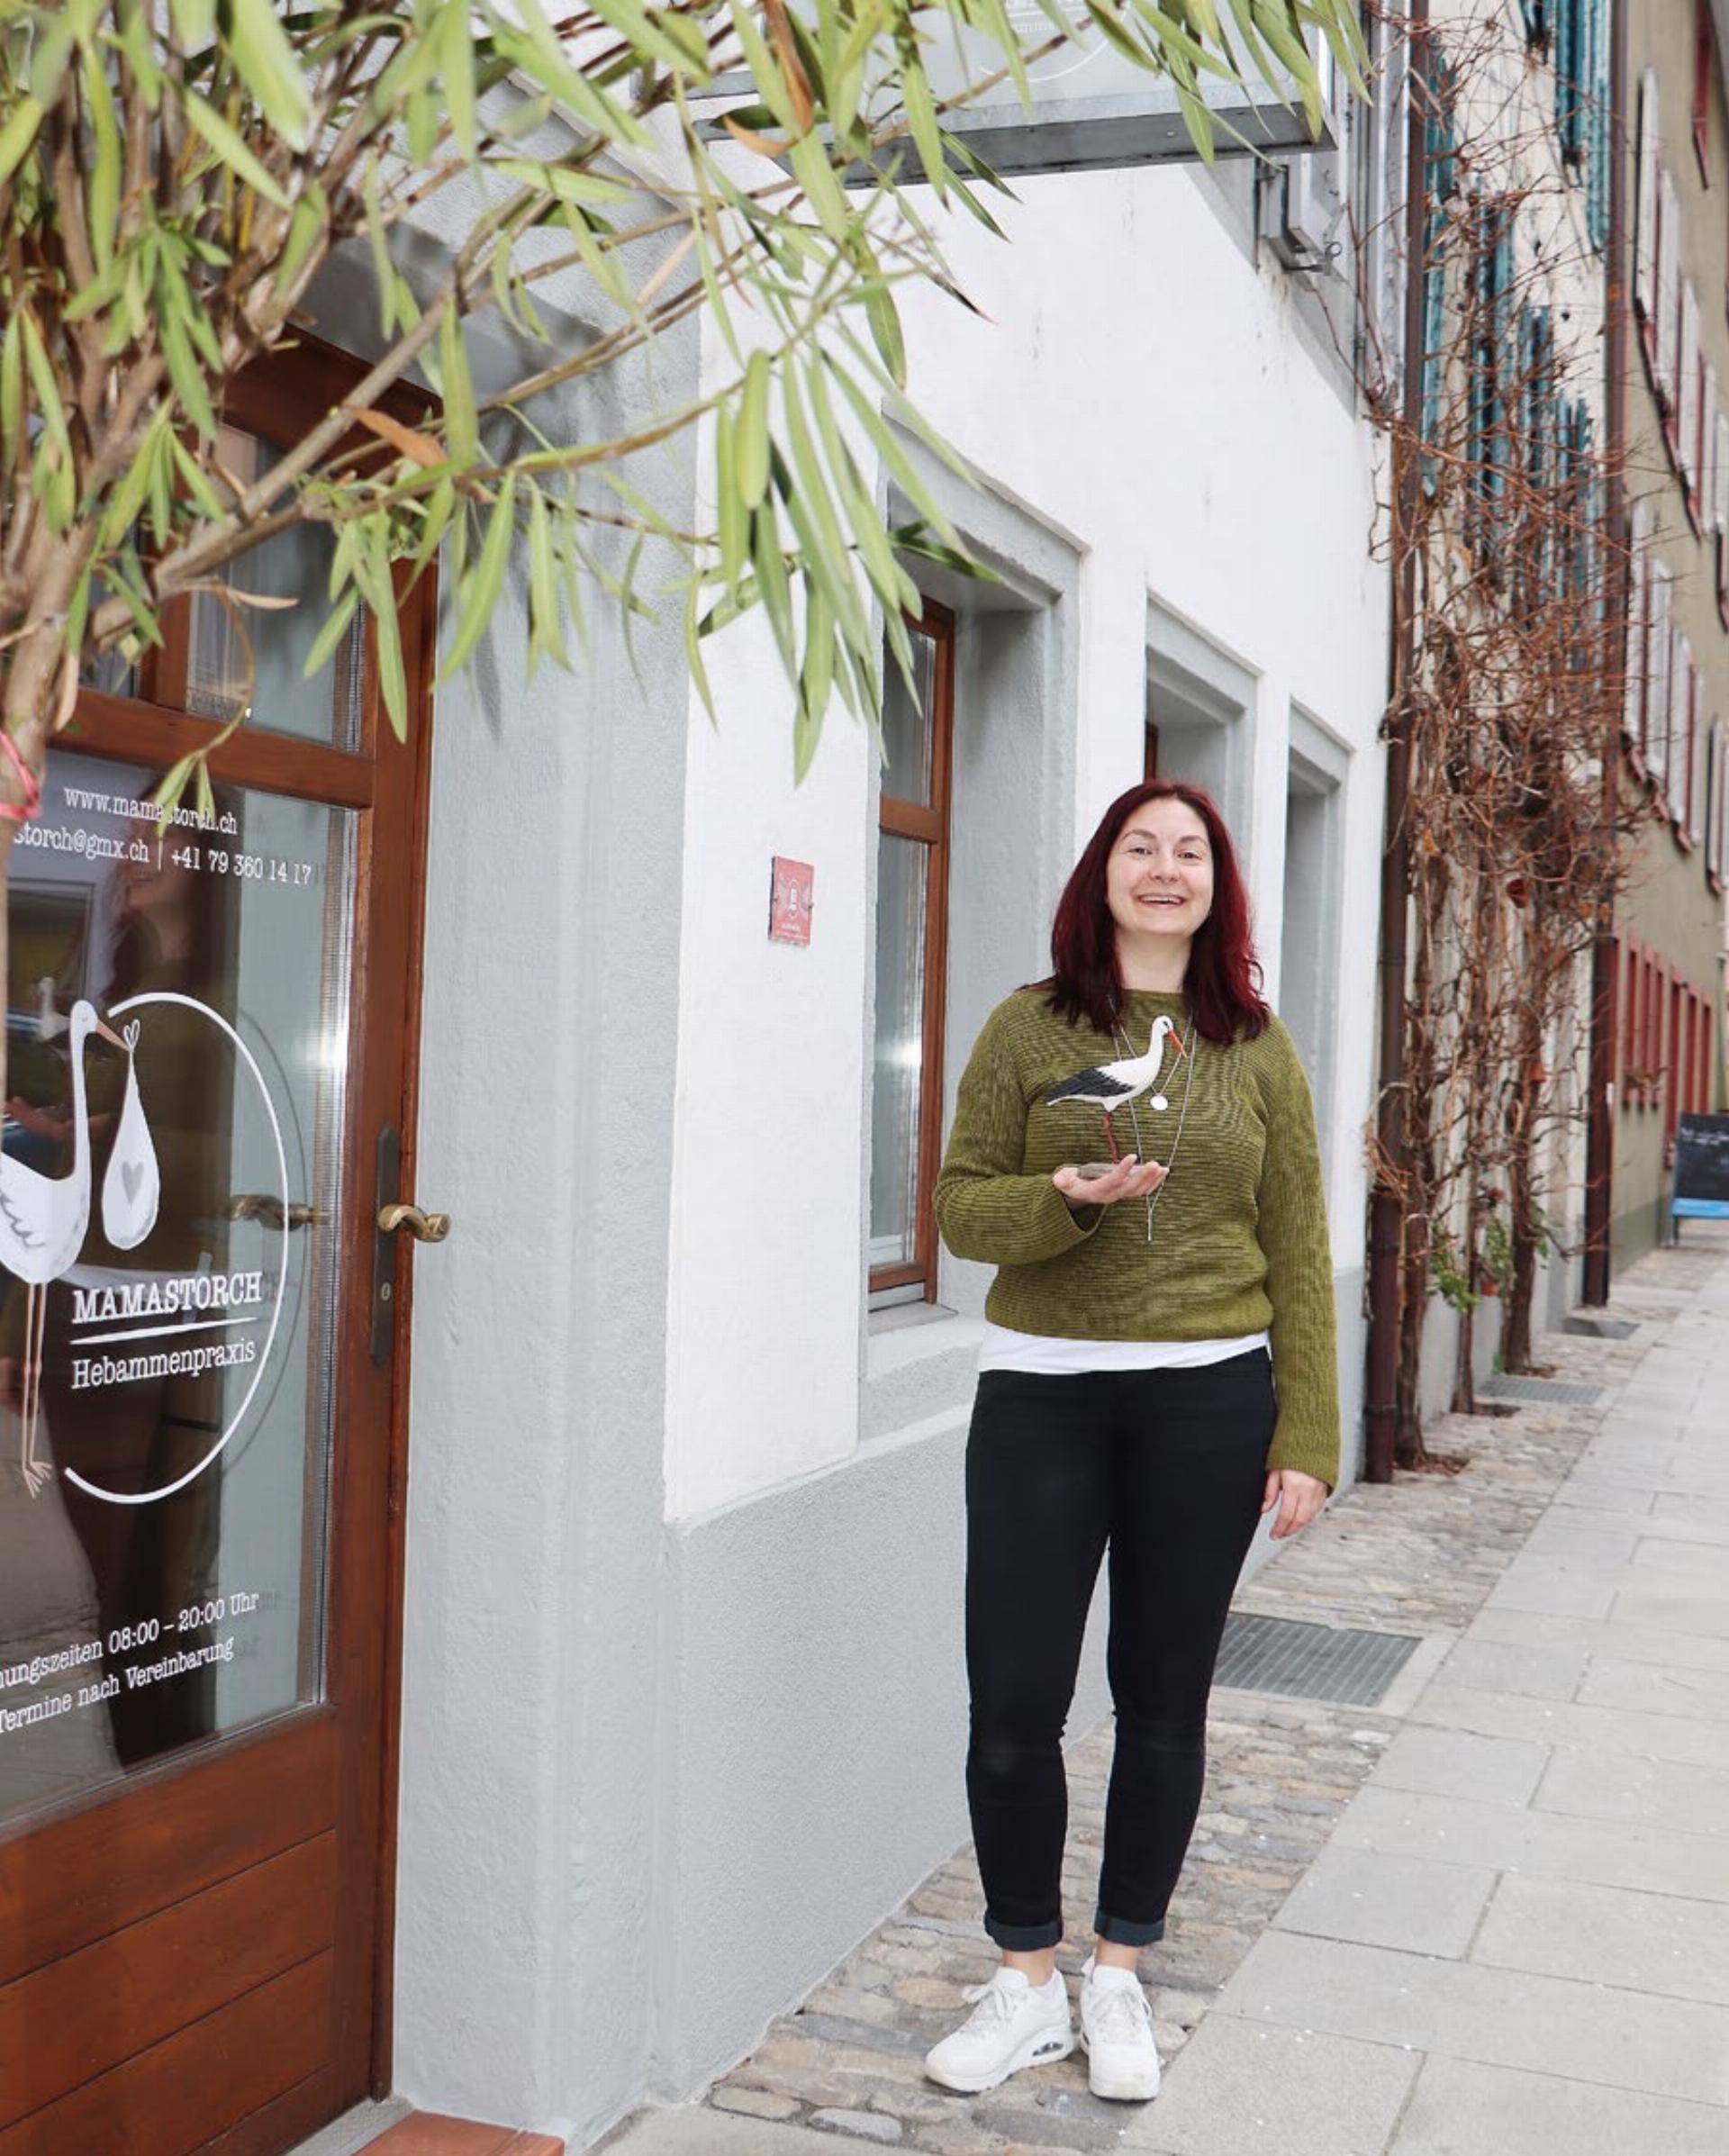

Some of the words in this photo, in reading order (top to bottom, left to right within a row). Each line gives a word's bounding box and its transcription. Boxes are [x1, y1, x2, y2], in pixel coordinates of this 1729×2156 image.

[171, 846, 201, 871] +41
[208, 850, 230, 874] 79
[233, 854, 264, 879] 360
[269, 859, 288, 883] 14
[294, 863, 312, 885] 17
[72, 1271, 263, 1325] MAMASTORCH
[71, 1336, 256, 1390] Hebammenpraxis
[109, 1618, 159, 1654] 08:00
[179, 1598, 225, 1632] 20:00
[230, 1591, 259, 1617] Uhr
[77, 1673, 121, 1707] nach
[125, 1636, 234, 1689] Vereinbarung
